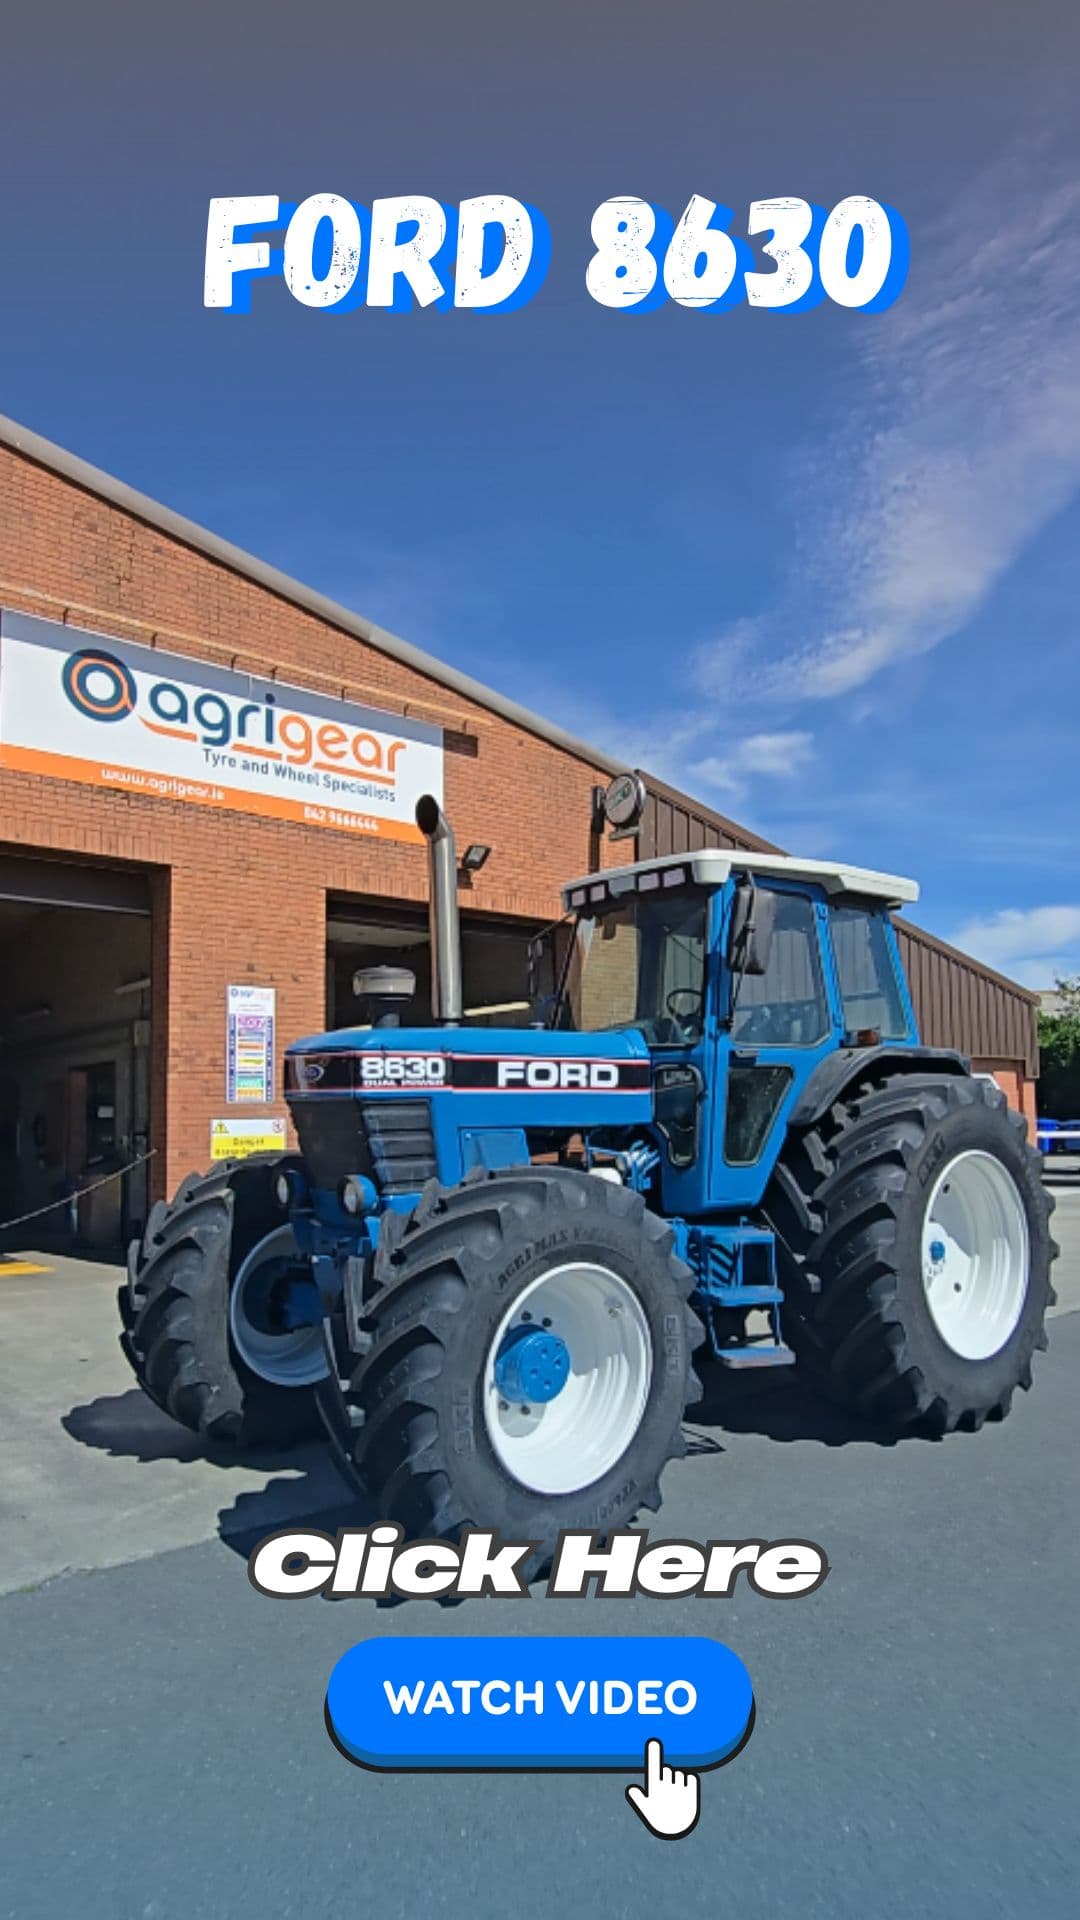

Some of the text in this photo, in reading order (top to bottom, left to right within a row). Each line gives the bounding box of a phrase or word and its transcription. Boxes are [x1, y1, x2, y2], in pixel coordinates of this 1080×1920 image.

[149, 683, 407, 772] agrigear
[203, 749, 396, 802] Tyre and Wheel Specialists
[361, 1057, 446, 1079] 8630
[497, 1062, 619, 1088] FORD
